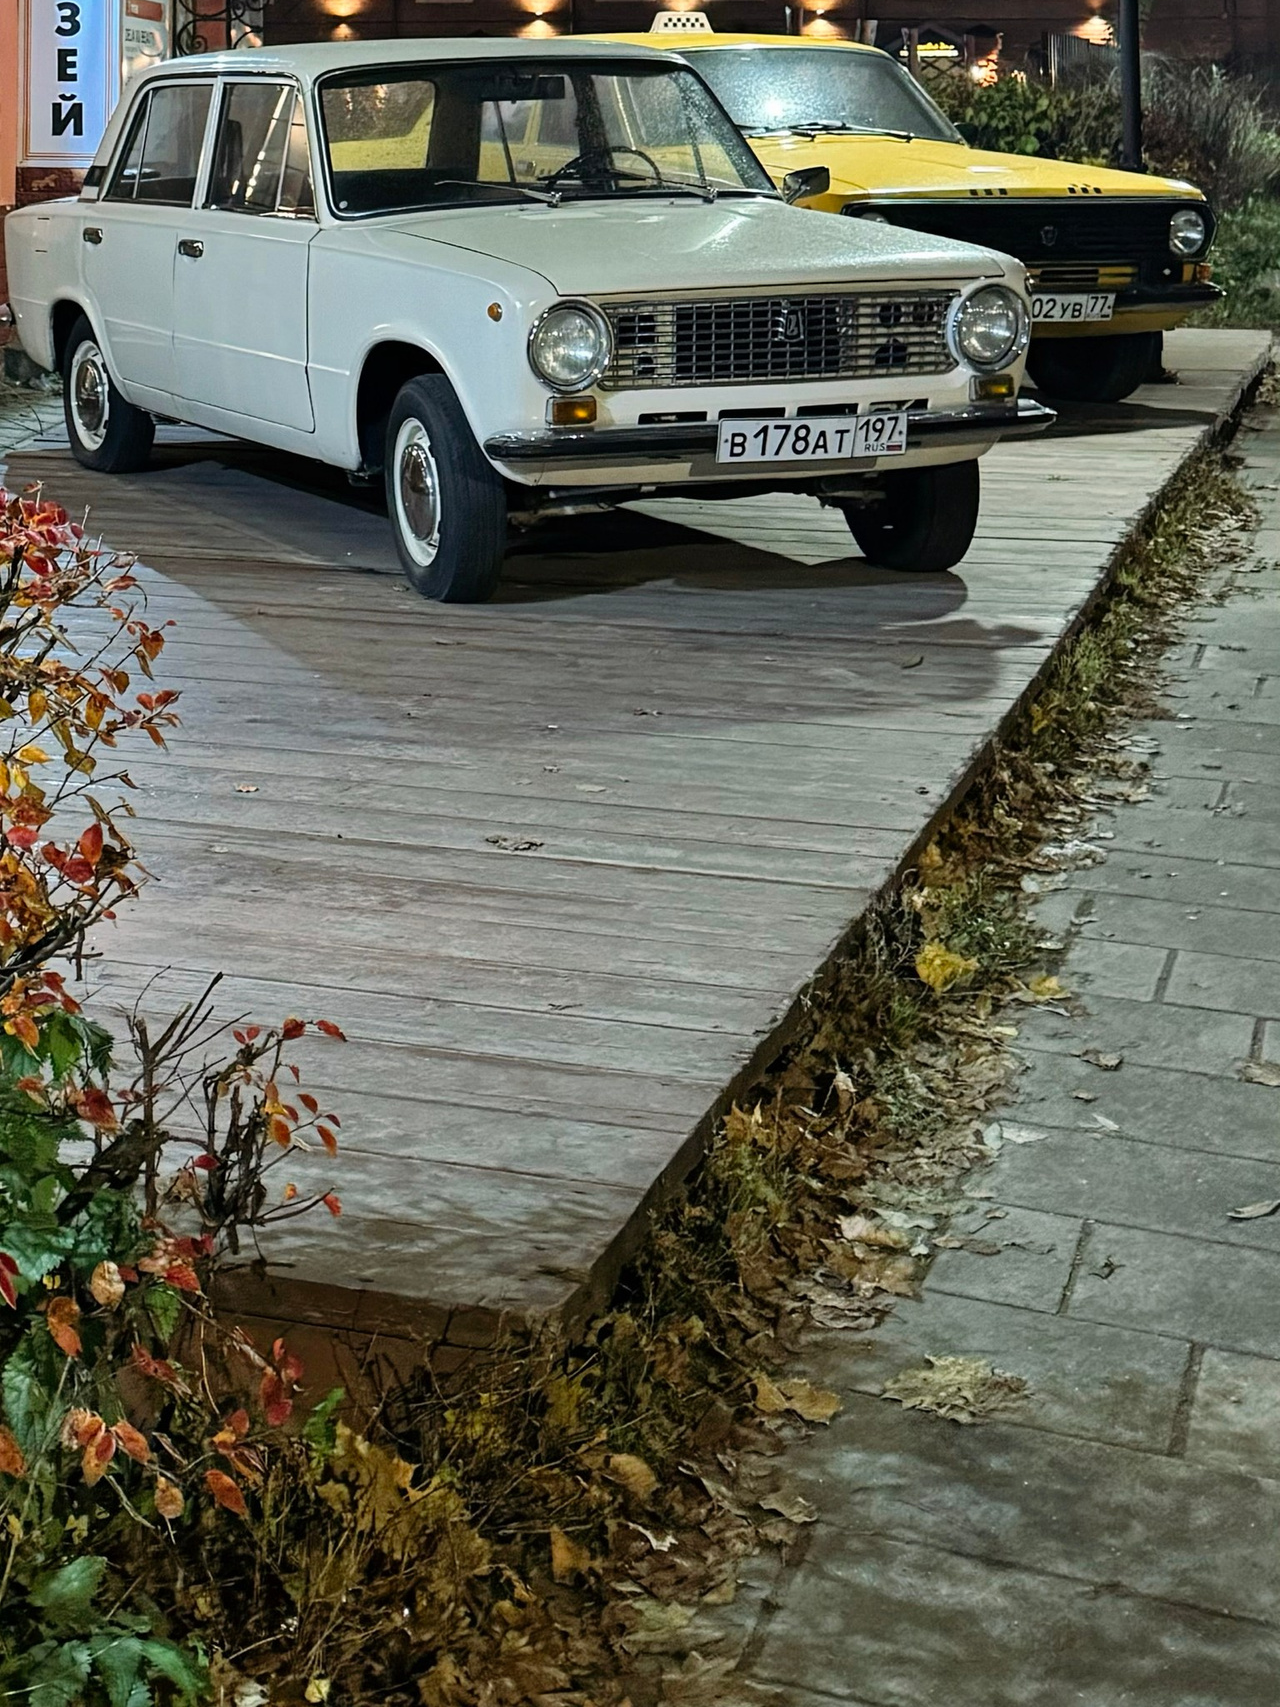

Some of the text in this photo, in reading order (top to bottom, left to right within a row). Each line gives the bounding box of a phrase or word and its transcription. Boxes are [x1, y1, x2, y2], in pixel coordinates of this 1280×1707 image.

[1091, 296, 1109, 313] 77
[729, 416, 900, 458] В178АТ 197
[864, 444, 886, 452] RUS
